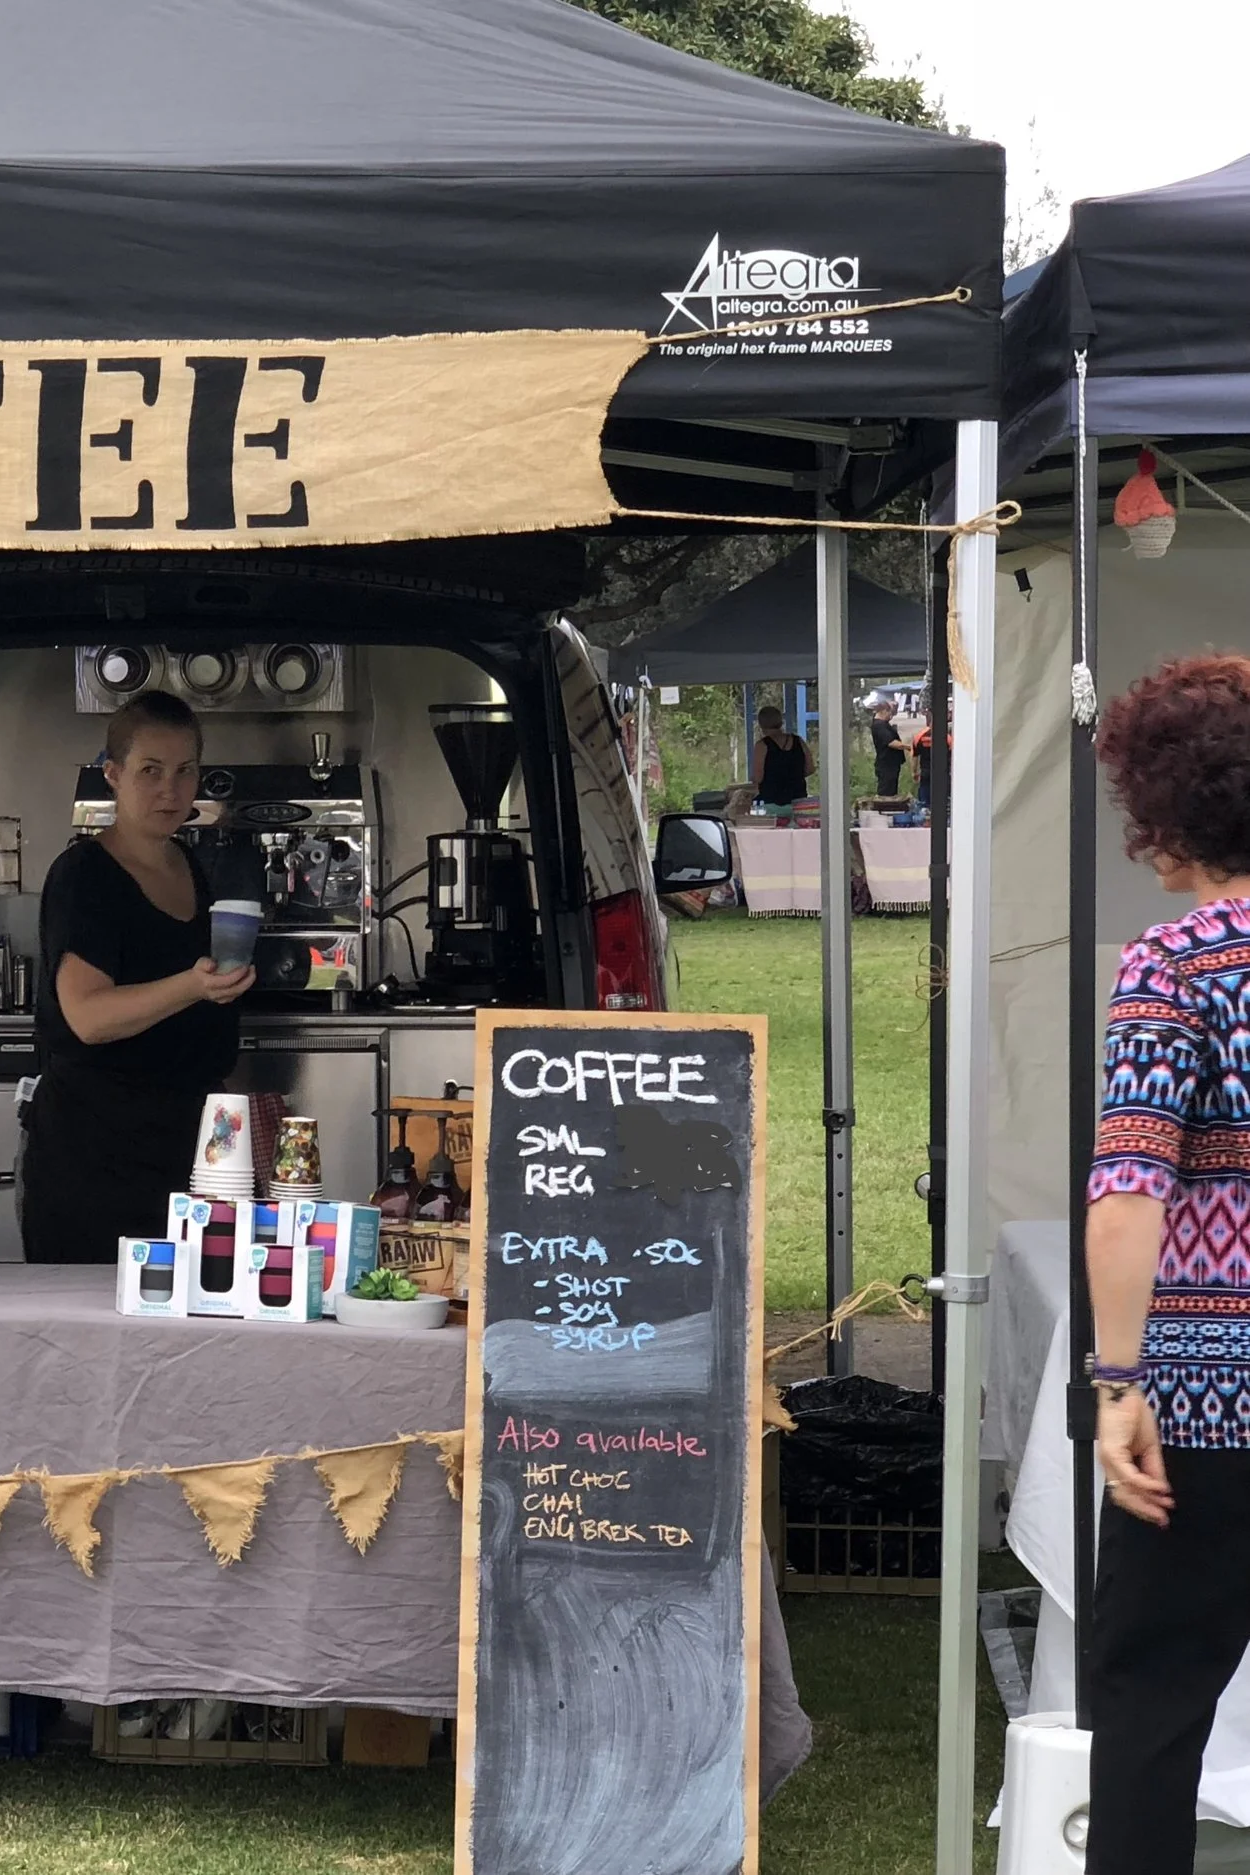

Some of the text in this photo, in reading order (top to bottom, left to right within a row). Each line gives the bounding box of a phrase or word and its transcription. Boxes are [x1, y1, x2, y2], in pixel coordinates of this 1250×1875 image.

[659, 232, 860, 336] Altegra
[718, 298, 859, 316] altegra.com.au
[785, 320, 823, 335] 784
[829, 319, 869, 335] 552
[659, 339, 893, 358] The original hex frame MARQUEES
[501, 1048, 720, 1106] COFFEE
[516, 1124, 607, 1158] SML
[524, 1163, 595, 1198] REG
[500, 1232, 609, 1266] EXTRA
[498, 1416, 707, 1457] Also available
[569, 1470, 631, 1491] CHOC
[523, 1492, 583, 1515] CHAI
[524, 1514, 694, 1547] ENG BREK TEA
